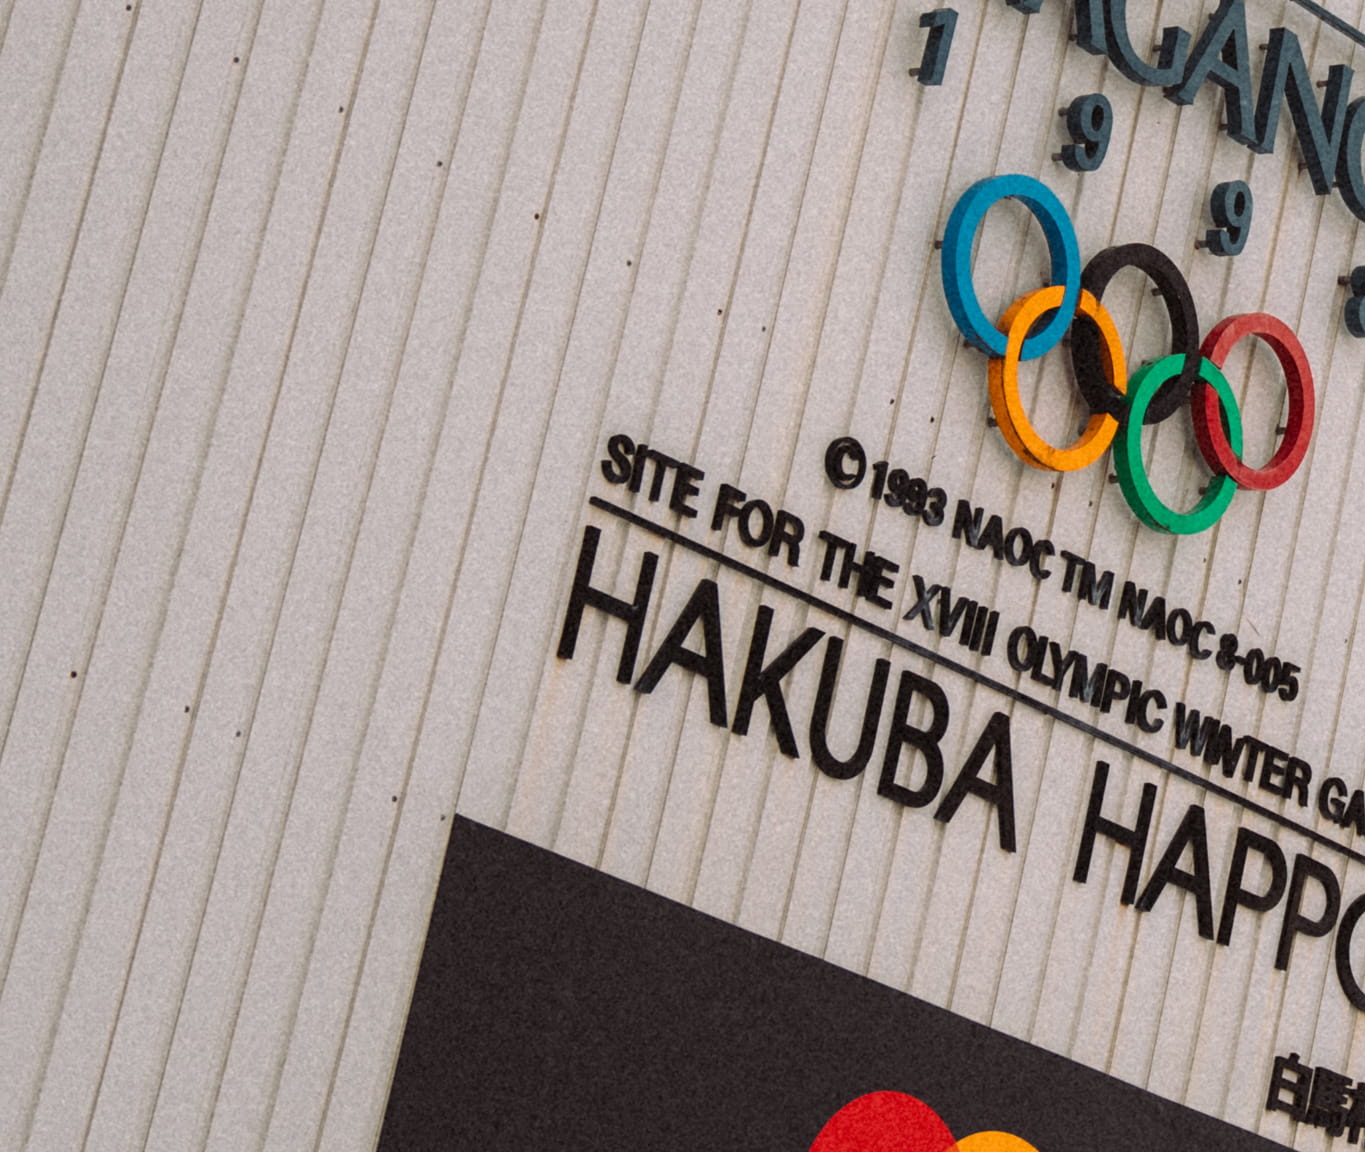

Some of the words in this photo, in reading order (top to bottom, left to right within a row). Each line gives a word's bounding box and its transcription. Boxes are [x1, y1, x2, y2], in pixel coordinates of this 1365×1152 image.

[557, 525, 1016, 853] HAKUBA
[601, 434, 704, 518] SITE
[711, 484, 804, 567] FOR
[818, 530, 899, 609] THE
[903, 575, 999, 656] XVIII
[1007, 624, 1167, 734] OLYMPIC
[1174, 702, 1311, 807] WINTER
[952, 500, 1054, 579] NAOC
[1060, 550, 1114, 609] TM
[1119, 581, 1216, 660] NAOC
